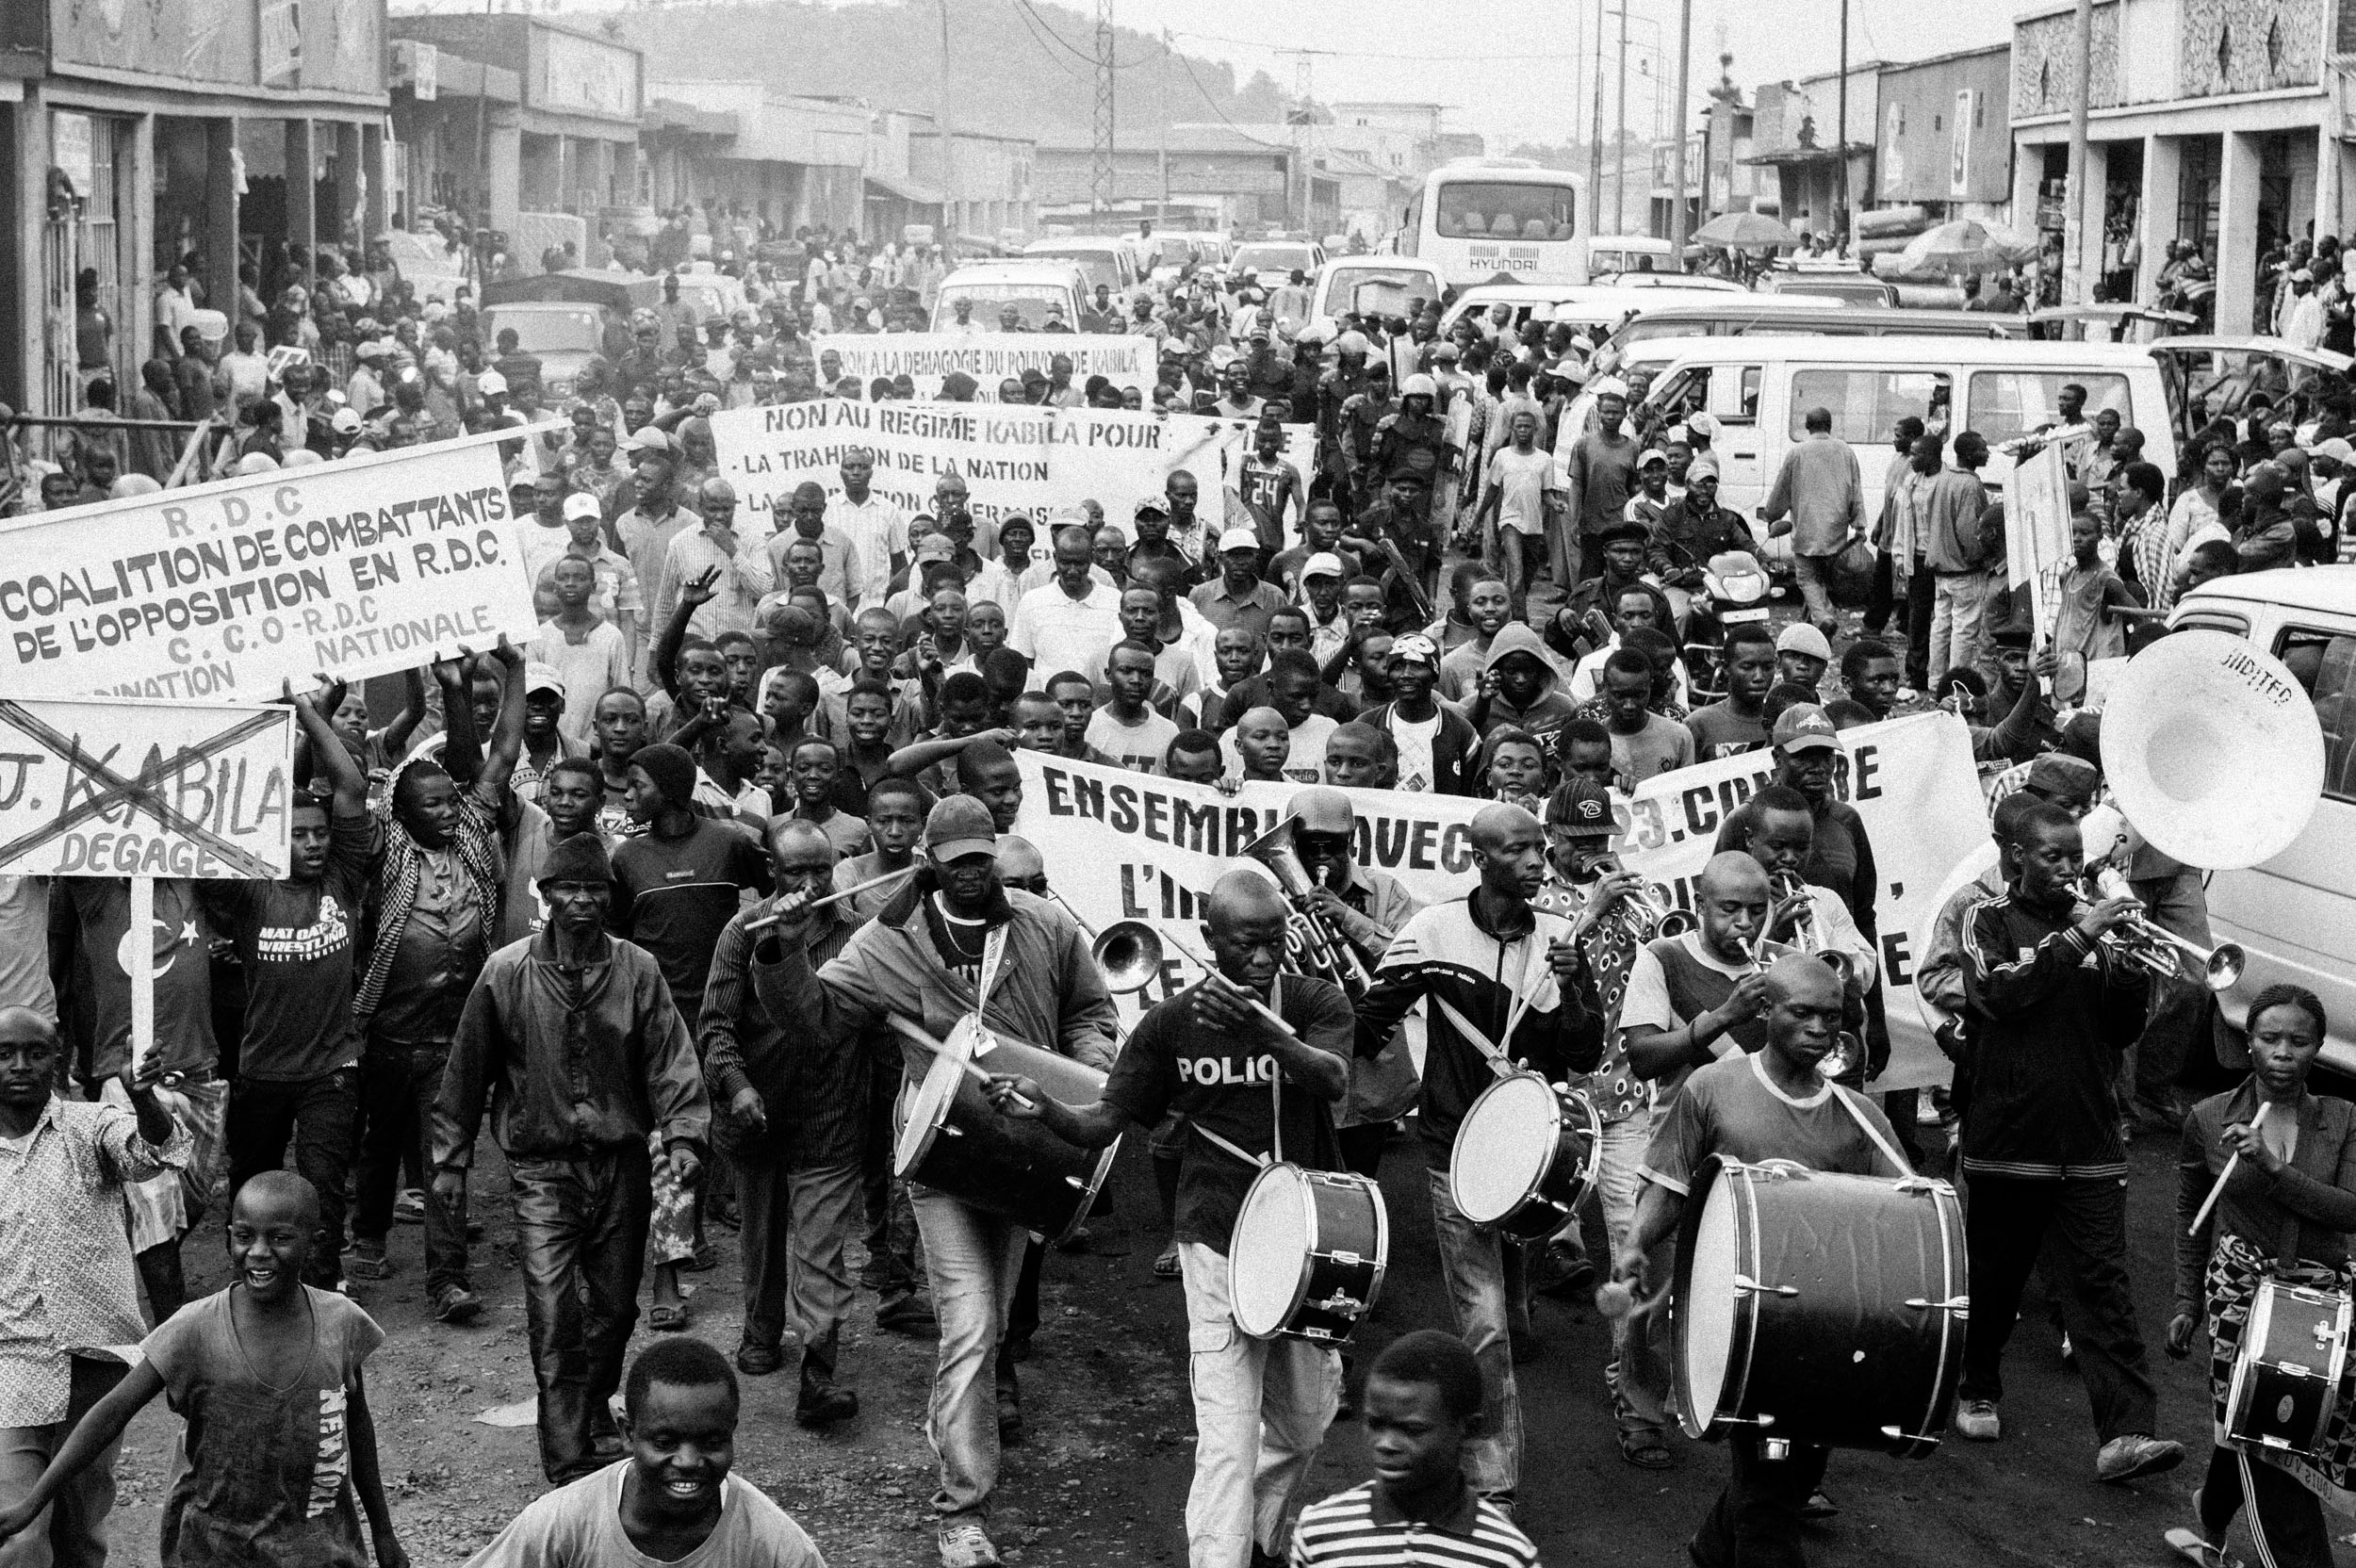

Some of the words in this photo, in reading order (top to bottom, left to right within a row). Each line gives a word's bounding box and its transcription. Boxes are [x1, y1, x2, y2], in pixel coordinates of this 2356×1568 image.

[1469, 258, 1538, 270] HYUNDAI
[884, 351, 901, 375] LA
[905, 350, 982, 375] DEMAGOGIE
[986, 350, 1004, 375] DU
[765, 402, 828, 433] NON
[836, 401, 871, 429] AU
[880, 409, 977, 442] REGIME
[986, 415, 1080, 447] KABILA
[1088, 422, 1161, 449] POUR
[898, 452, 924, 474] DE
[933, 456, 957, 476] LA
[967, 458, 1049, 482] NATION
[1252, 477, 1279, 506] 24
[0, 540, 230, 622] COALITION
[233, 529, 282, 572] DE
[285, 486, 506, 562] COMBATTANTS
[13, 625, 62, 663] DE
[70, 566, 331, 653] L'OPPOSITION
[350, 551, 400, 592] EN
[413, 530, 506, 579] R.D.C.
[315, 605, 496, 667] NATIONALE
[56, 732, 287, 846] KABILA
[53, 833, 220, 879] DEGAGE
[259, 926, 294, 939] MAT
[257, 952, 291, 962] LACEY
[299, 937, 350, 962] TOWNSHIP
[1175, 1054, 1293, 1086] POLIC
